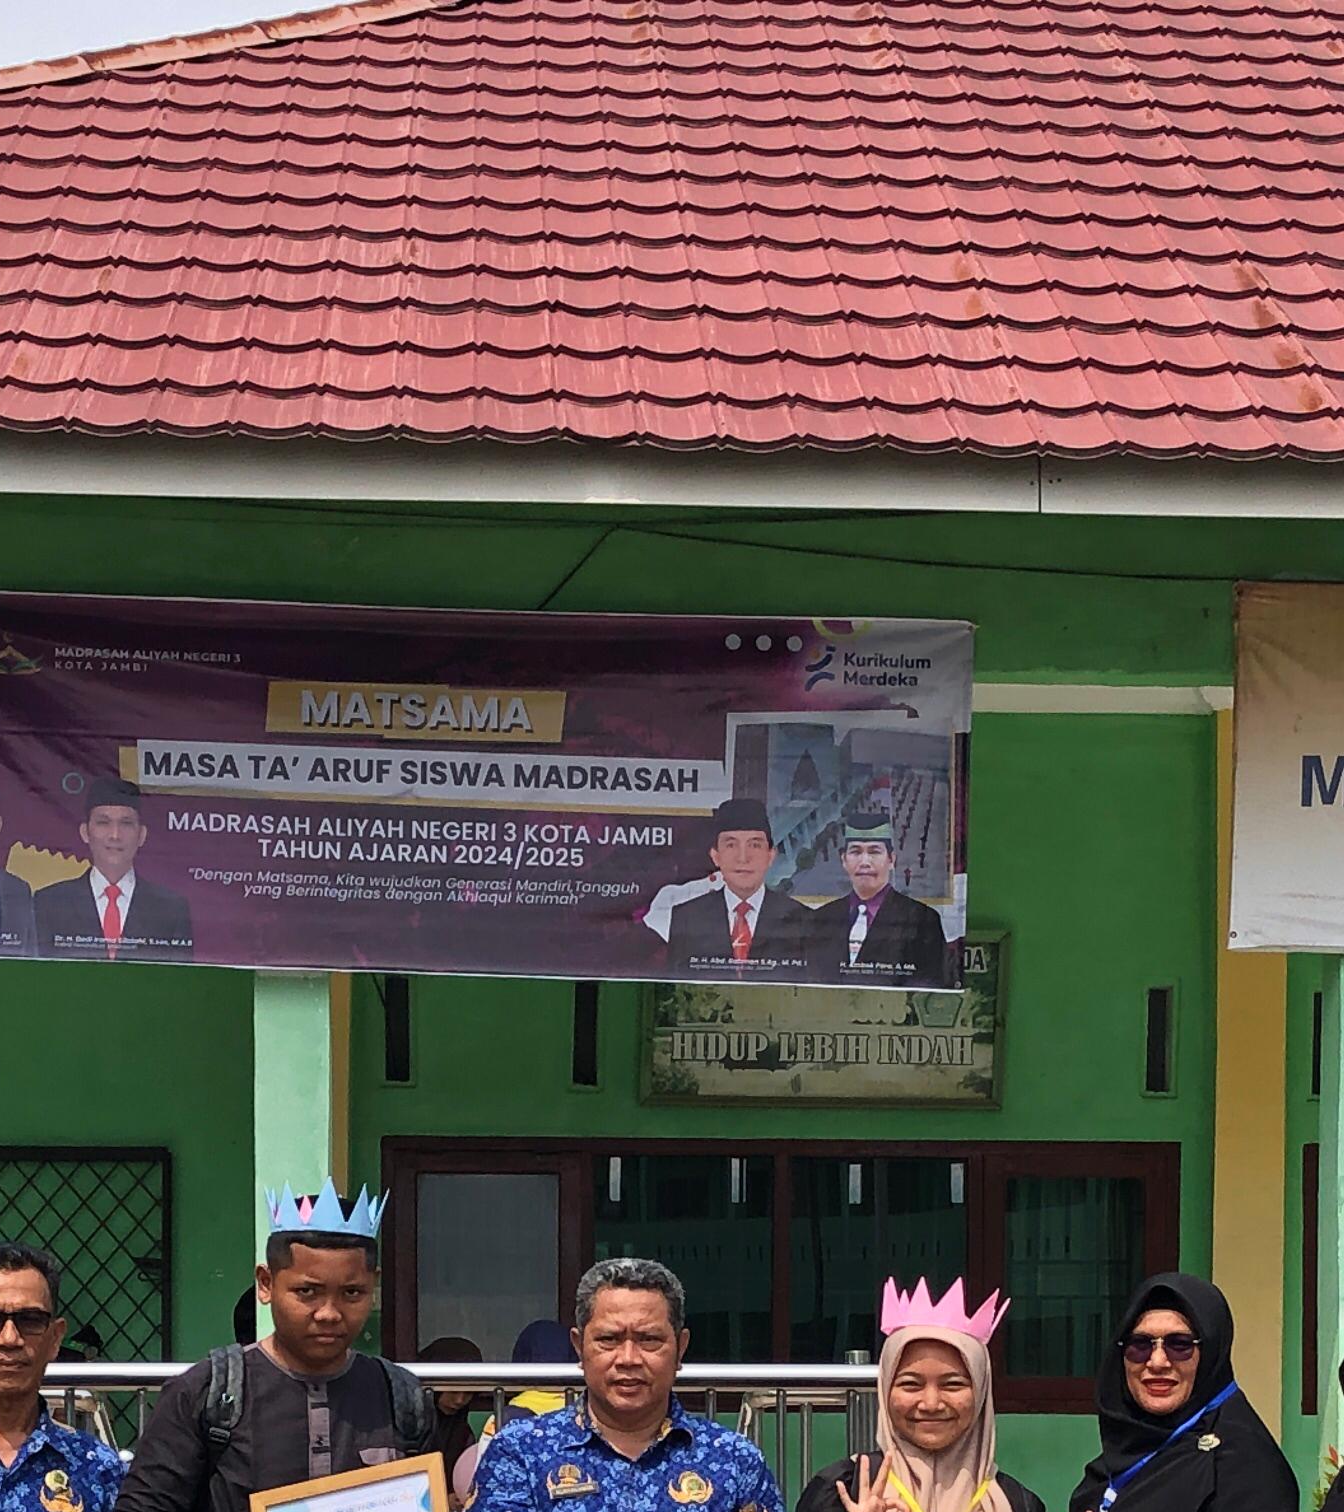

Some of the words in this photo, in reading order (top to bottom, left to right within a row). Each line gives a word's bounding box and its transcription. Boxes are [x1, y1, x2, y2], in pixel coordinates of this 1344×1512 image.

[55, 647, 129, 659] MADRASAH
[133, 650, 179, 661] ALIYAH
[184, 652, 231, 663] NEGERI
[234, 654, 242, 664] 3
[55, 661, 94, 671] KOTA
[101, 662, 148, 672] JAMBI
[844, 653, 931, 669] Kurikulum
[844, 671, 918, 686] Merdeka
[301, 690, 534, 733] MATSAMA
[144, 751, 240, 779] MASA
[308, 757, 392, 784] ARUF
[400, 760, 505, 788] SISWA
[513, 764, 699, 793] MADRASAH
[168, 811, 310, 836] MADRASAH
[317, 817, 404, 839] ALIYAH
[411, 820, 496, 842] NEGERI
[504, 822, 516, 842] 3
[524, 824, 590, 845] KOTA
[598, 827, 673, 846] JAMBI
[258, 838, 341, 860] TAHUN
[348, 842, 448, 864] AJARAN
[454, 841, 584, 869] 2024/2025
[257, 871, 331, 887] Matsama,
[336, 873, 364, 887] Kita
[369, 874, 441, 893] wujudkan
[445, 877, 512, 891] Generasi
[244, 884, 281, 899] yang
[286, 884, 380, 901] Berintegritas
[384, 888, 442, 905] dengan
[447, 890, 511, 906] Akhlaqul
[671, 1030, 768, 1062] HIDUP
[778, 1032, 869, 1064] LEBIH
[878, 1034, 974, 1066] INDAH
